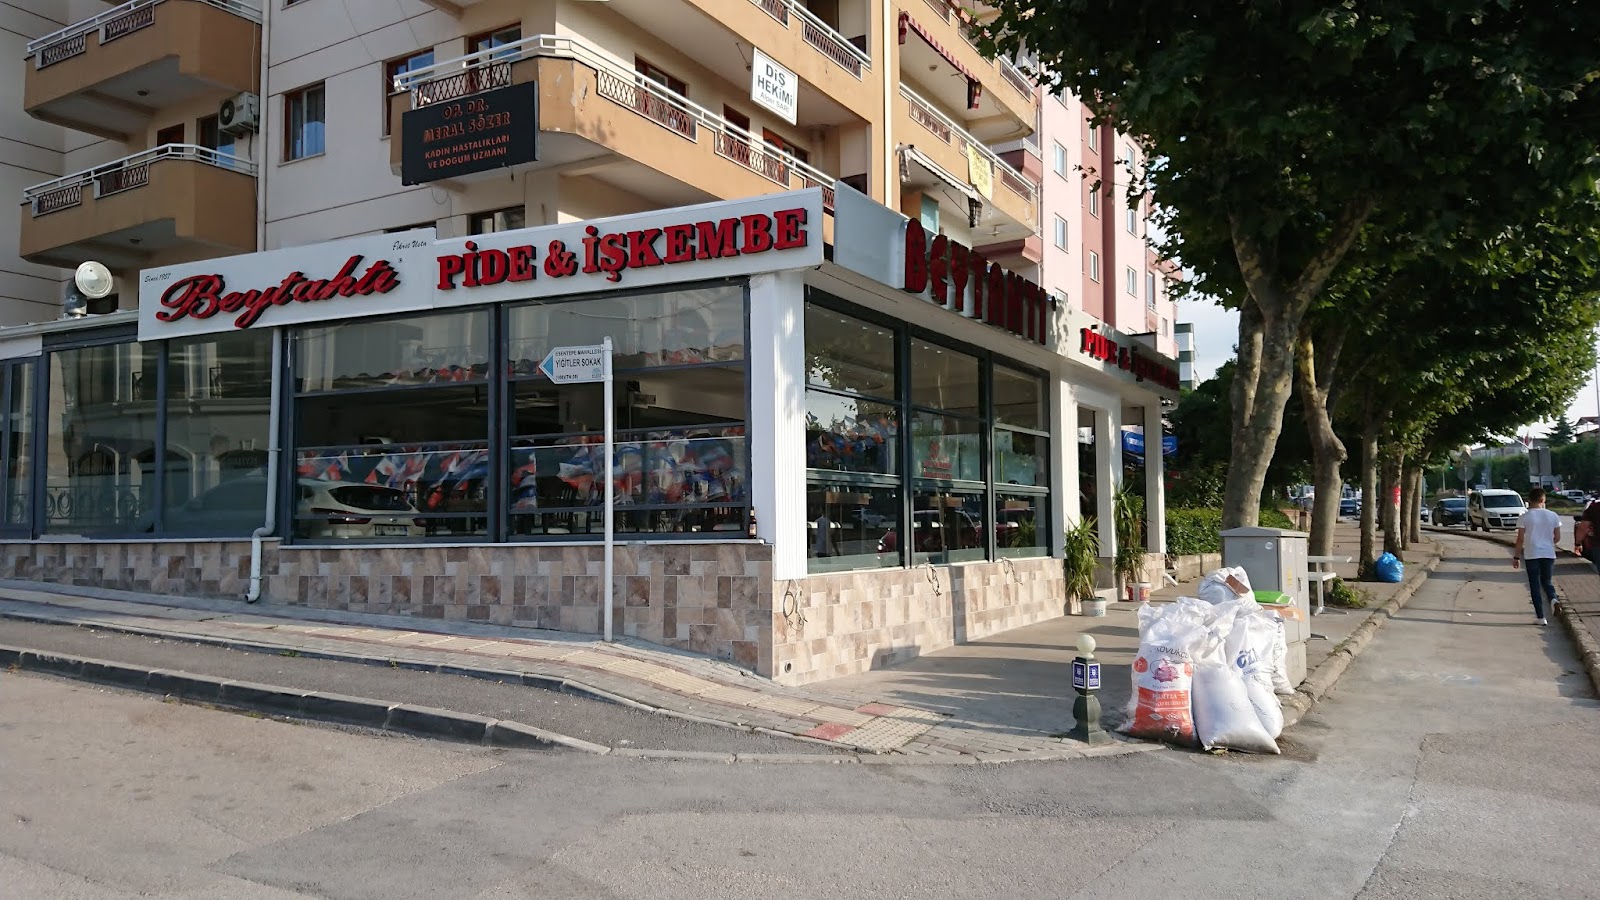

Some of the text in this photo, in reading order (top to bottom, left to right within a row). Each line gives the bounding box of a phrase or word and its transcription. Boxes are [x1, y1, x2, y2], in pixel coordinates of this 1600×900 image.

[423, 111, 511, 143] MERAL SÖZER
[425, 134, 510, 159] KADIN HASTALIKLARI
[427, 161, 437, 169] VE
[472, 147, 507, 160] UZMANI
[436, 207, 808, 290] PİDE & İŞKEMBE
[581, 358, 601, 367] SOKAK
